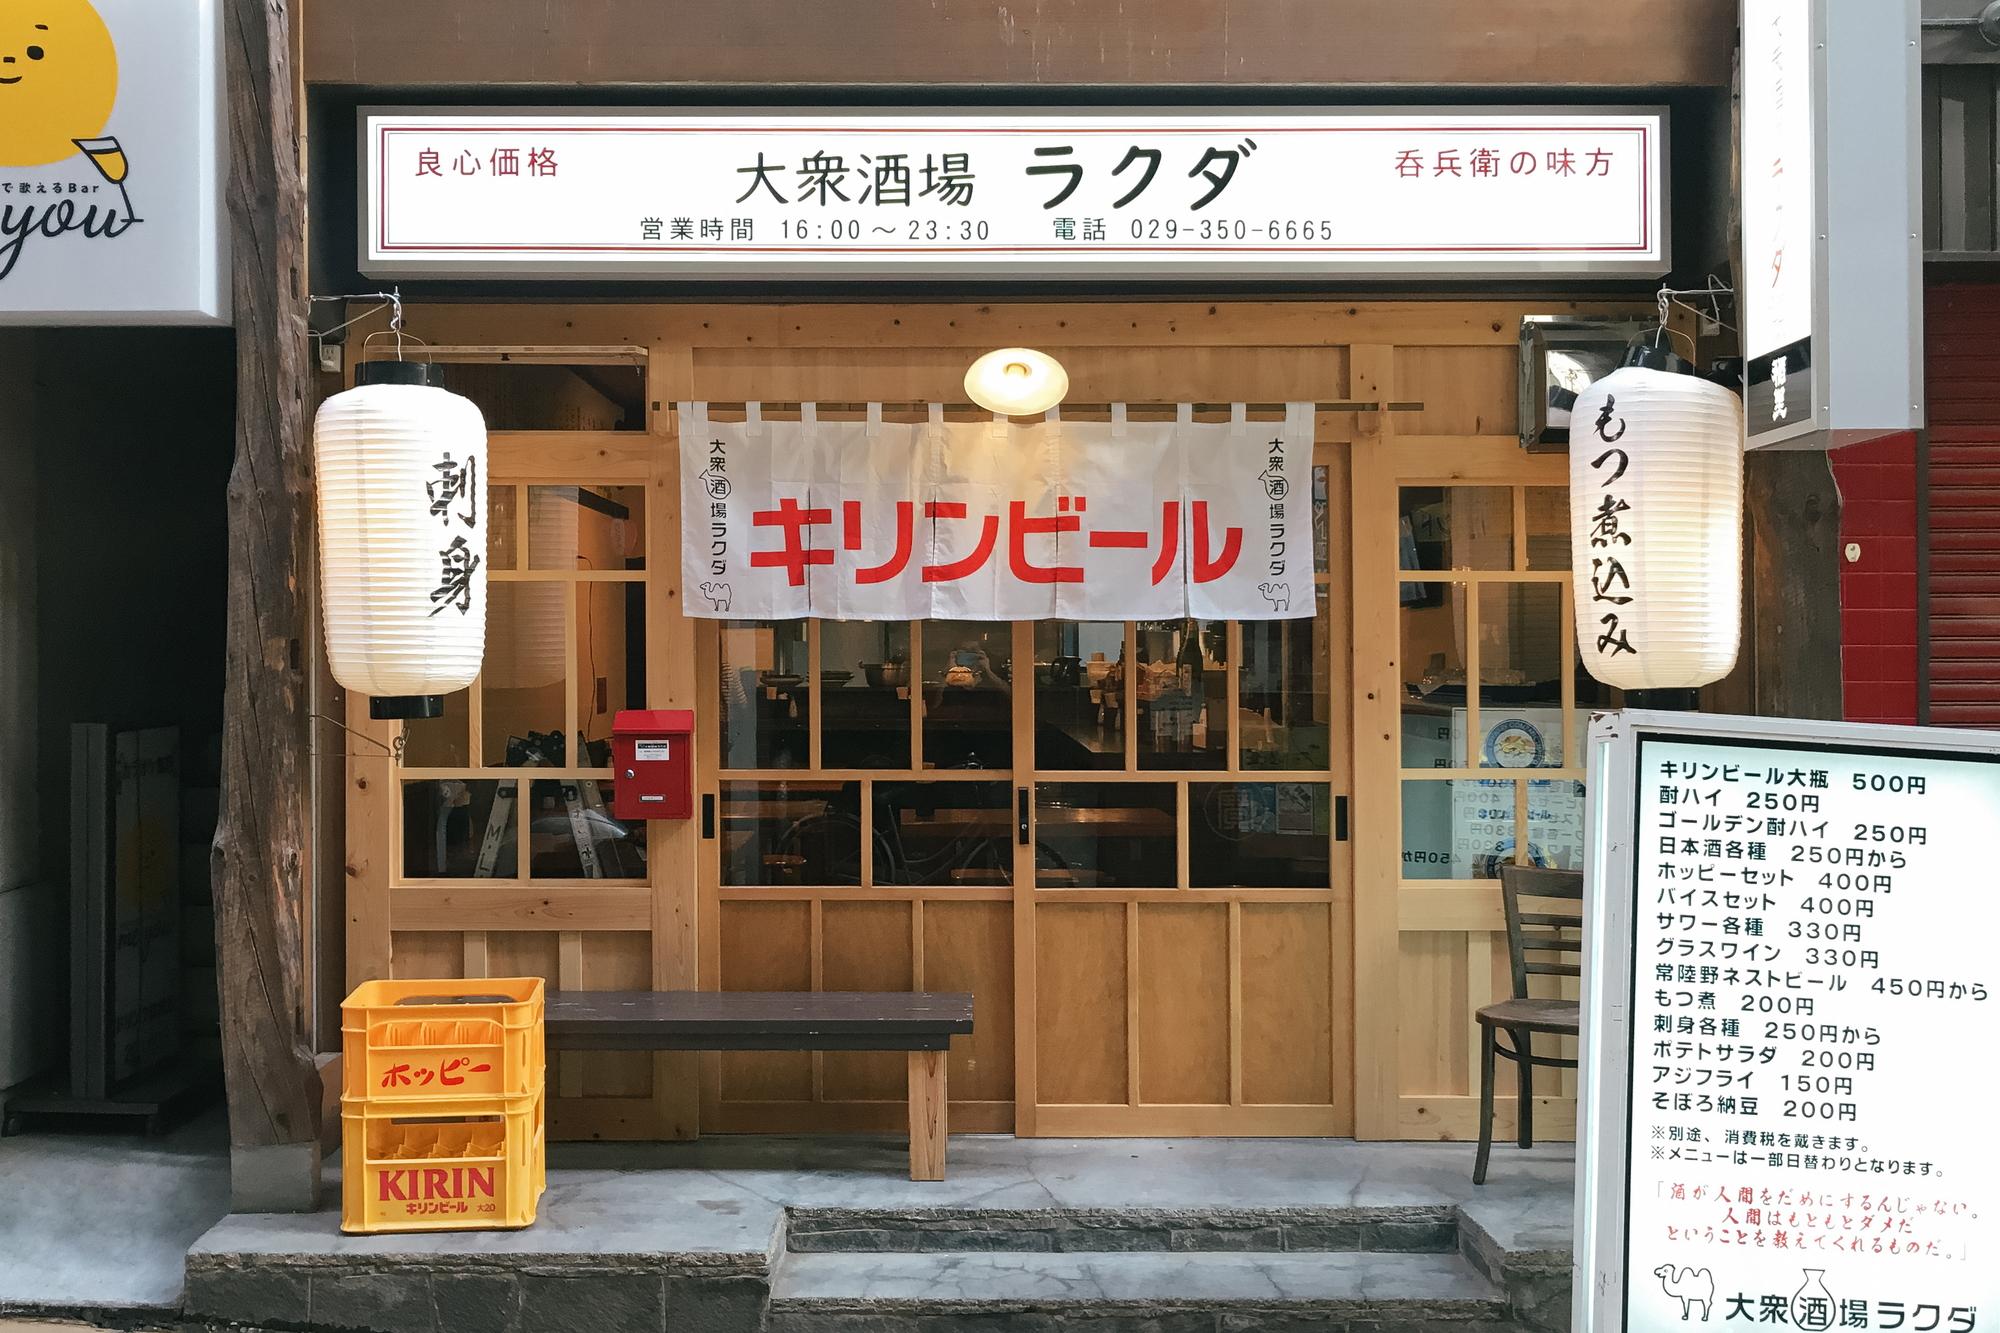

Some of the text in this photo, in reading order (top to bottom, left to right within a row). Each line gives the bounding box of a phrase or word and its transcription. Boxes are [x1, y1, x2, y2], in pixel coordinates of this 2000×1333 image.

[416, 147, 558, 176] 良心価格
[736, 138, 1257, 211] 大衆酒場 ラクダ
[1396, 148, 1613, 177] 呑兵衛の味方
[641, 217, 752, 241] 営業時間
[1053, 218, 1105, 240] 電話
[1132, 219, 1331, 240] 029-350-6665
[709, 439, 728, 576] 大衆酒場ラクダ
[1268, 438, 1286, 577] 大衆酒場ラクダ
[425, 451, 481, 618] 刺身
[1590, 393, 1638, 657] もつ煮込み
[750, 495, 1244, 587] キリンビール
[1660, 761, 1925, 795] キリンビール大瓶 500円
[1747, 792, 1819, 813] 250円
[1854, 824, 1926, 845] 250円
[1660, 836, 1906, 868] 日本酒各種 250円から
[1658, 862, 1891, 893] ホッピーセット 400円
[1658, 888, 1873, 917] バイスセット 400円
[1657, 913, 1860, 941] サワー各種 330円
[1657, 938, 1878, 969] グラスワイン 330円
[1656, 963, 1987, 1000] 常陸野ネストビール 450円から
[1655, 989, 1813, 1016] もつ煮 200円
[1654, 1014, 1880, 1045] 刺身各種 250円から
[1654, 1040, 1874, 1071] ポテトサラダ 200円
[382, 1057, 491, 1088] ホッピー
[1653, 1066, 1851, 1095] アジフライ 150円
[1652, 1092, 1856, 1121] そぼろ納豆 200円
[1652, 1126, 1867, 1154] ※別途、消費税を戴きます。
[1652, 1145, 1942, 1177] ※メニューは一部日替わりとなります。
[379, 1167, 495, 1201] KIRIN
[406, 1202, 468, 1215] キリンビール
[1722, 1207, 1912, 1234] 人間はもともとダメだ
[1726, 1292, 1976, 1333] 大衆酒場ラクダ
